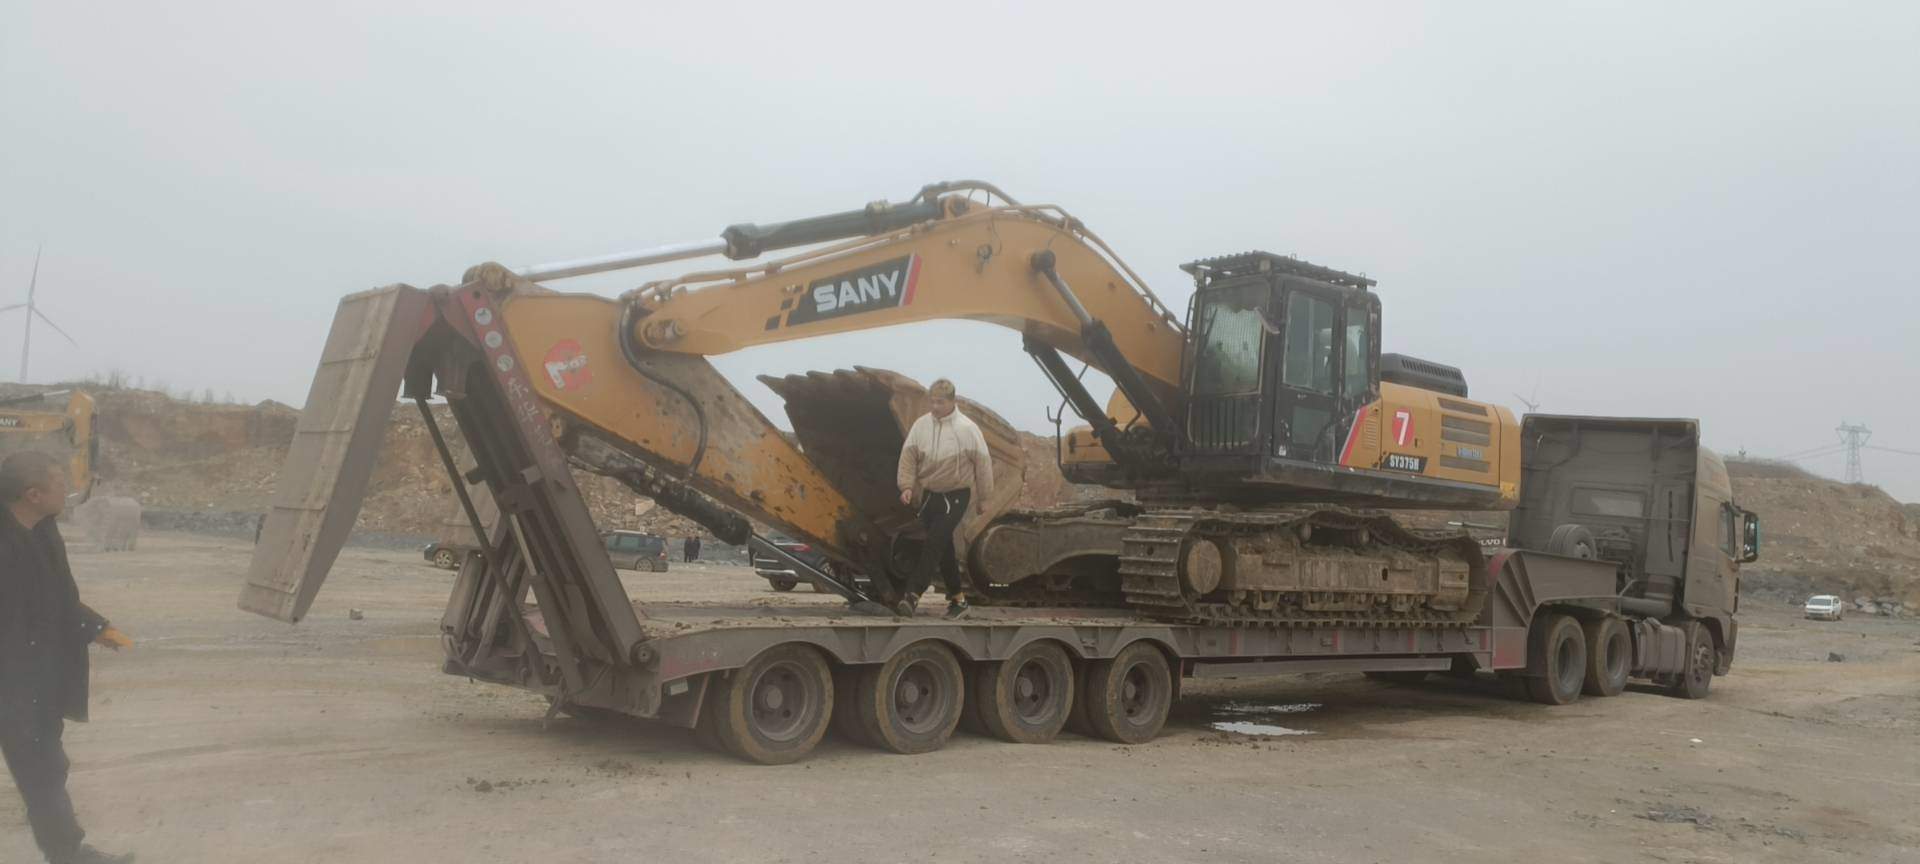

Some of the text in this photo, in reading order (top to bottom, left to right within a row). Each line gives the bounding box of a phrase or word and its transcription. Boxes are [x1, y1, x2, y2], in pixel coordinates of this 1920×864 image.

[813, 270, 900, 313] SANY
[0, 417, 16, 428] ANY
[1396, 411, 1410, 446] 7
[1389, 454, 1420, 471] SY375H
